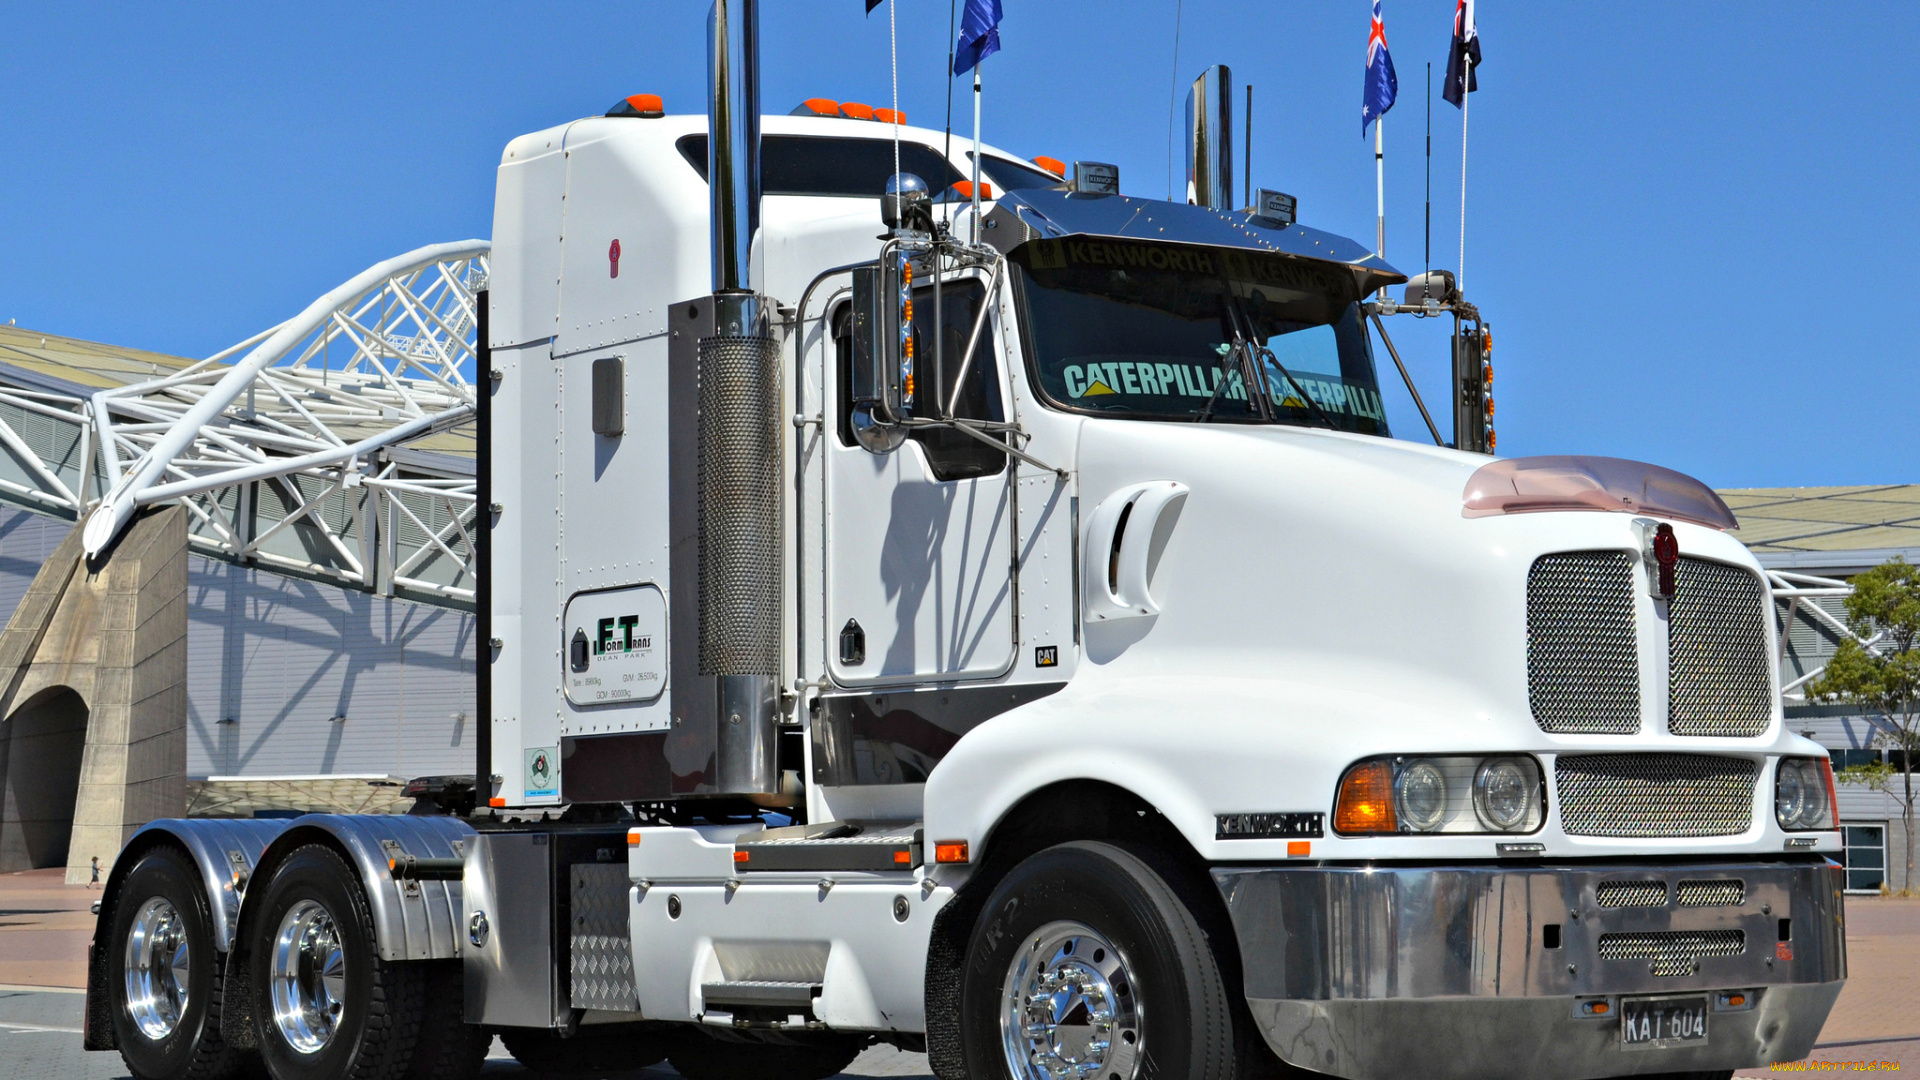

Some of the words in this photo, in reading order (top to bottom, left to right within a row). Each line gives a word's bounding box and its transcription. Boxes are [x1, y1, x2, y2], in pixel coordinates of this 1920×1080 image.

[1068, 241, 1214, 275] KENWORTH
[1063, 361, 1249, 401] CATERPILLAR
[1268, 375, 1385, 422] CATERPILLA
[1037, 648, 1055, 665] CAT
[1216, 813, 1323, 834] KENWORTH
